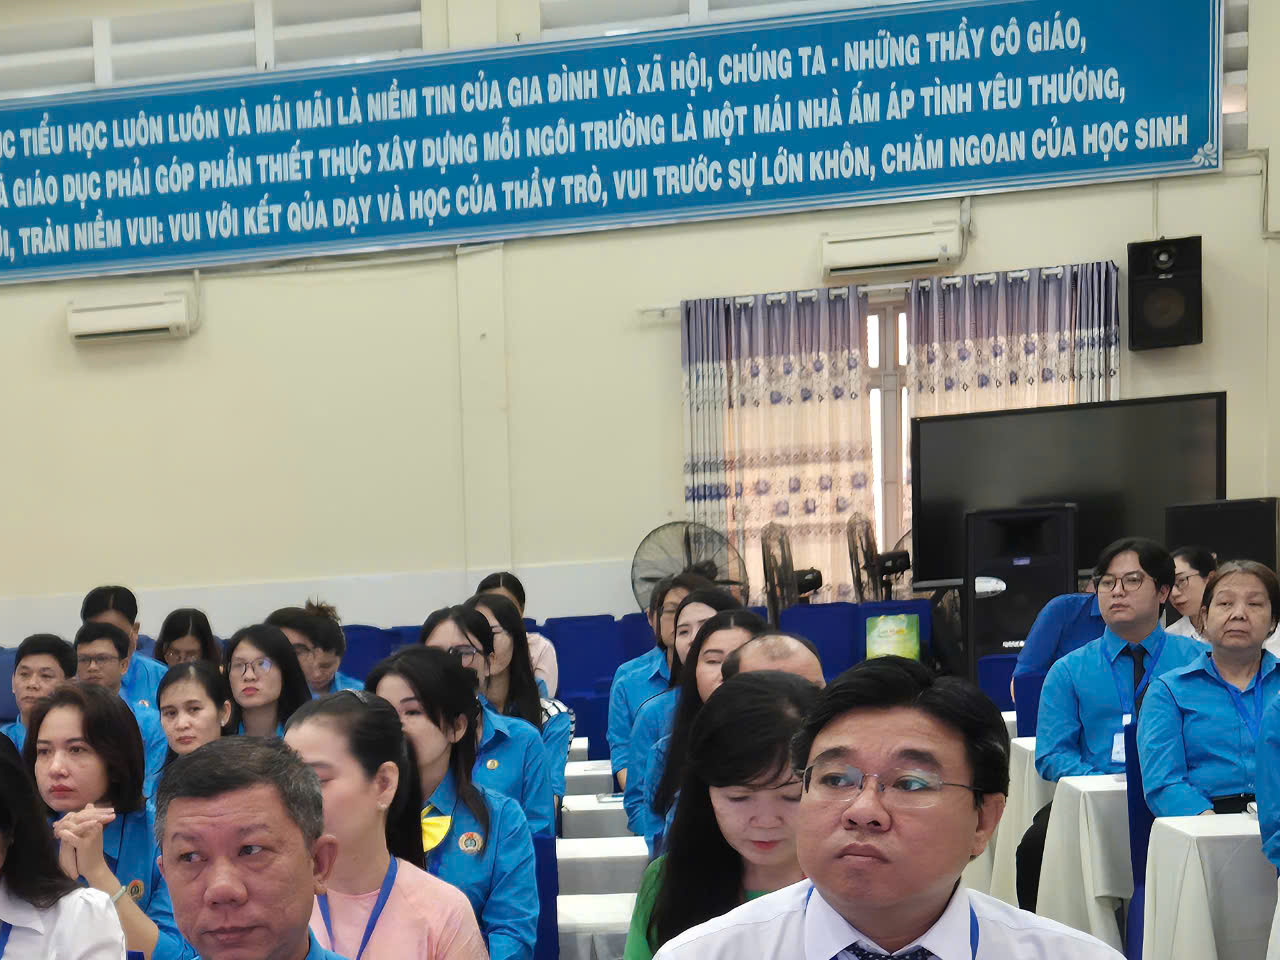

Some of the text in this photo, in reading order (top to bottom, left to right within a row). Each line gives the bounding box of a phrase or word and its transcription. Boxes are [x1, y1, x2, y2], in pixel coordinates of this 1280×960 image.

[12, 168, 59, 208] GIÁO
[62, 170, 102, 210] DỤC
[105, 155, 151, 199] PHẢI
[154, 154, 195, 195] GÓP
[198, 145, 253, 190] PHẦN
[255, 138, 314, 185] THIẾT
[318, 138, 372, 185] THỰC
[376, 134, 417, 173] XÂY
[421, 129, 479, 175] DỰNG
[482, 115, 521, 162] MỖI
[525, 117, 576, 158] NGÔI
[580, 108, 666, 152] TRƯỜNG
[671, 102, 698, 143] LÀ
[702, 99, 748, 146] MỘT
[753, 93, 792, 135] MÁI
[797, 87, 844, 130] NHÀ
[848, 80, 881, 125] ẤM
[885, 80, 916, 121] ÁP
[919, 76, 973, 117] TÌNH
[977, 71, 1022, 112] YÊU
[1027, 63, 1126, 107] THƯƠNG,
[19, 111, 64, 157] TIỂU
[67, 120, 109, 160] HỌC
[111, 109, 164, 149] LUÔN
[167, 104, 220, 143] LUÔN
[223, 98, 252, 137] VÀ
[254, 94, 292, 135] MÃI
[295, 89, 333, 130] MÃI
[336, 86, 363, 126] LÀ
[366, 77, 418, 123] NIỀM
[421, 83, 457, 117] TIN
[460, 69, 504, 113] CỦA
[506, 74, 544, 108] GIA
[546, 63, 599, 104] ĐÌNH
[602, 57, 632, 98] VÀ
[636, 53, 666, 95] XÃ
[670, 51, 713, 97] HỘI,
[717, 42, 793, 86] CHÚNG
[797, 44, 827, 77] TA
[843, 28, 921, 73] NHỮNG
[925, 15, 985, 63] THẦY
[990, 16, 1021, 57] CÔ
[1026, 10, 1087, 54] GIÁO,
[18, 216, 71, 256] TRÀN
[73, 208, 123, 252] NIỀM
[125, 215, 165, 246] VUI:
[167, 211, 201, 243] VUI
[204, 200, 239, 240] VỚI
[243, 192, 283, 236] KẾT
[332, 194, 372, 235] DẠY
[376, 183, 405, 223] VÀ
[408, 186, 452, 227] HỌC
[455, 173, 498, 216] CỦA
[501, 166, 556, 211] THẦY
[560, 164, 609, 208] TRÒ,
[612, 167, 648, 201] VUI
[652, 153, 723, 197] TRƯỚC
[727, 151, 758, 197] SỰ
[761, 145, 804, 186] LỚN
[808, 140, 876, 182] KHÔN,
[880, 132, 944, 175] CHĂM
[949, 130, 1026, 168] NGOAN
[1031, 115, 1077, 161] CỦA
[1082, 119, 1129, 162] HỌC
[1134, 113, 1189, 151] SINH
